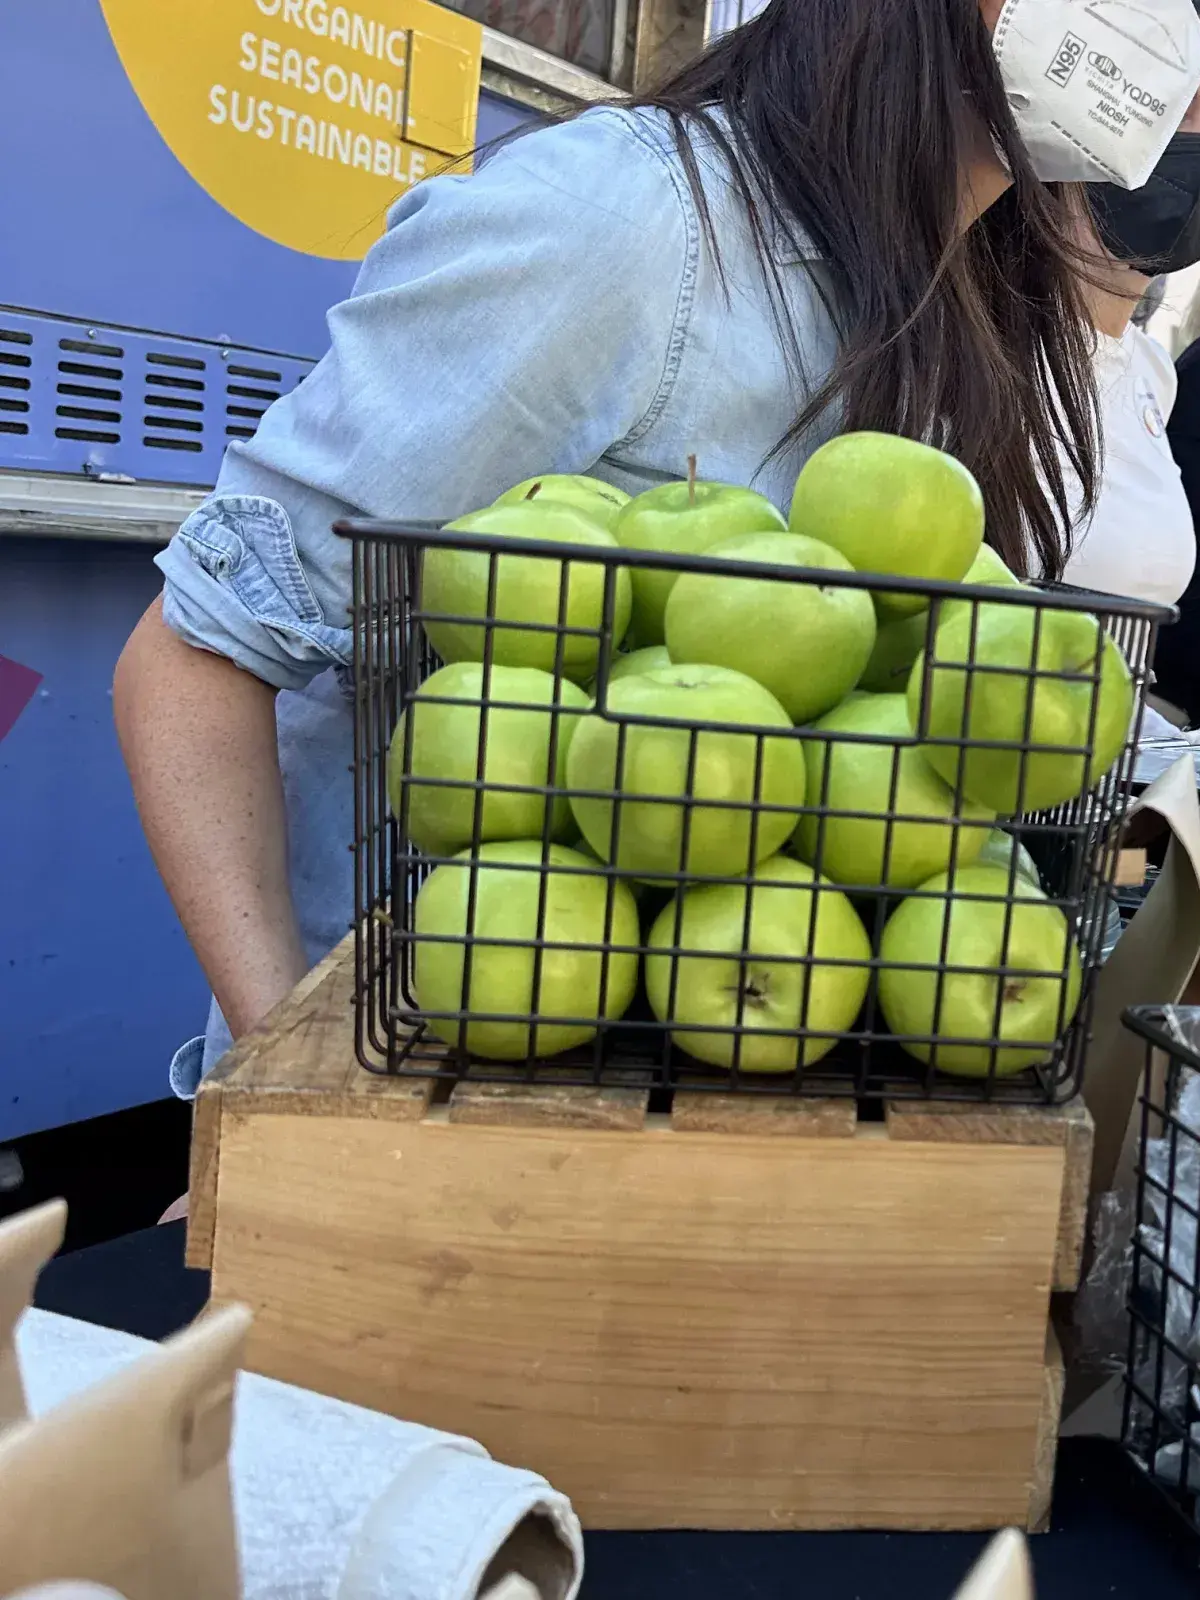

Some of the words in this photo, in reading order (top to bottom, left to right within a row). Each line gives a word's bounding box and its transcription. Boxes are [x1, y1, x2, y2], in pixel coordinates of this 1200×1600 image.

[239, 32, 416, 127] SEASONAL
[1051, 39, 1081, 81] N95
[1096, 100, 1130, 126] NIOSH
[1122, 78, 1168, 117] YQD95
[207, 84, 426, 184] SUSTAINABLE
